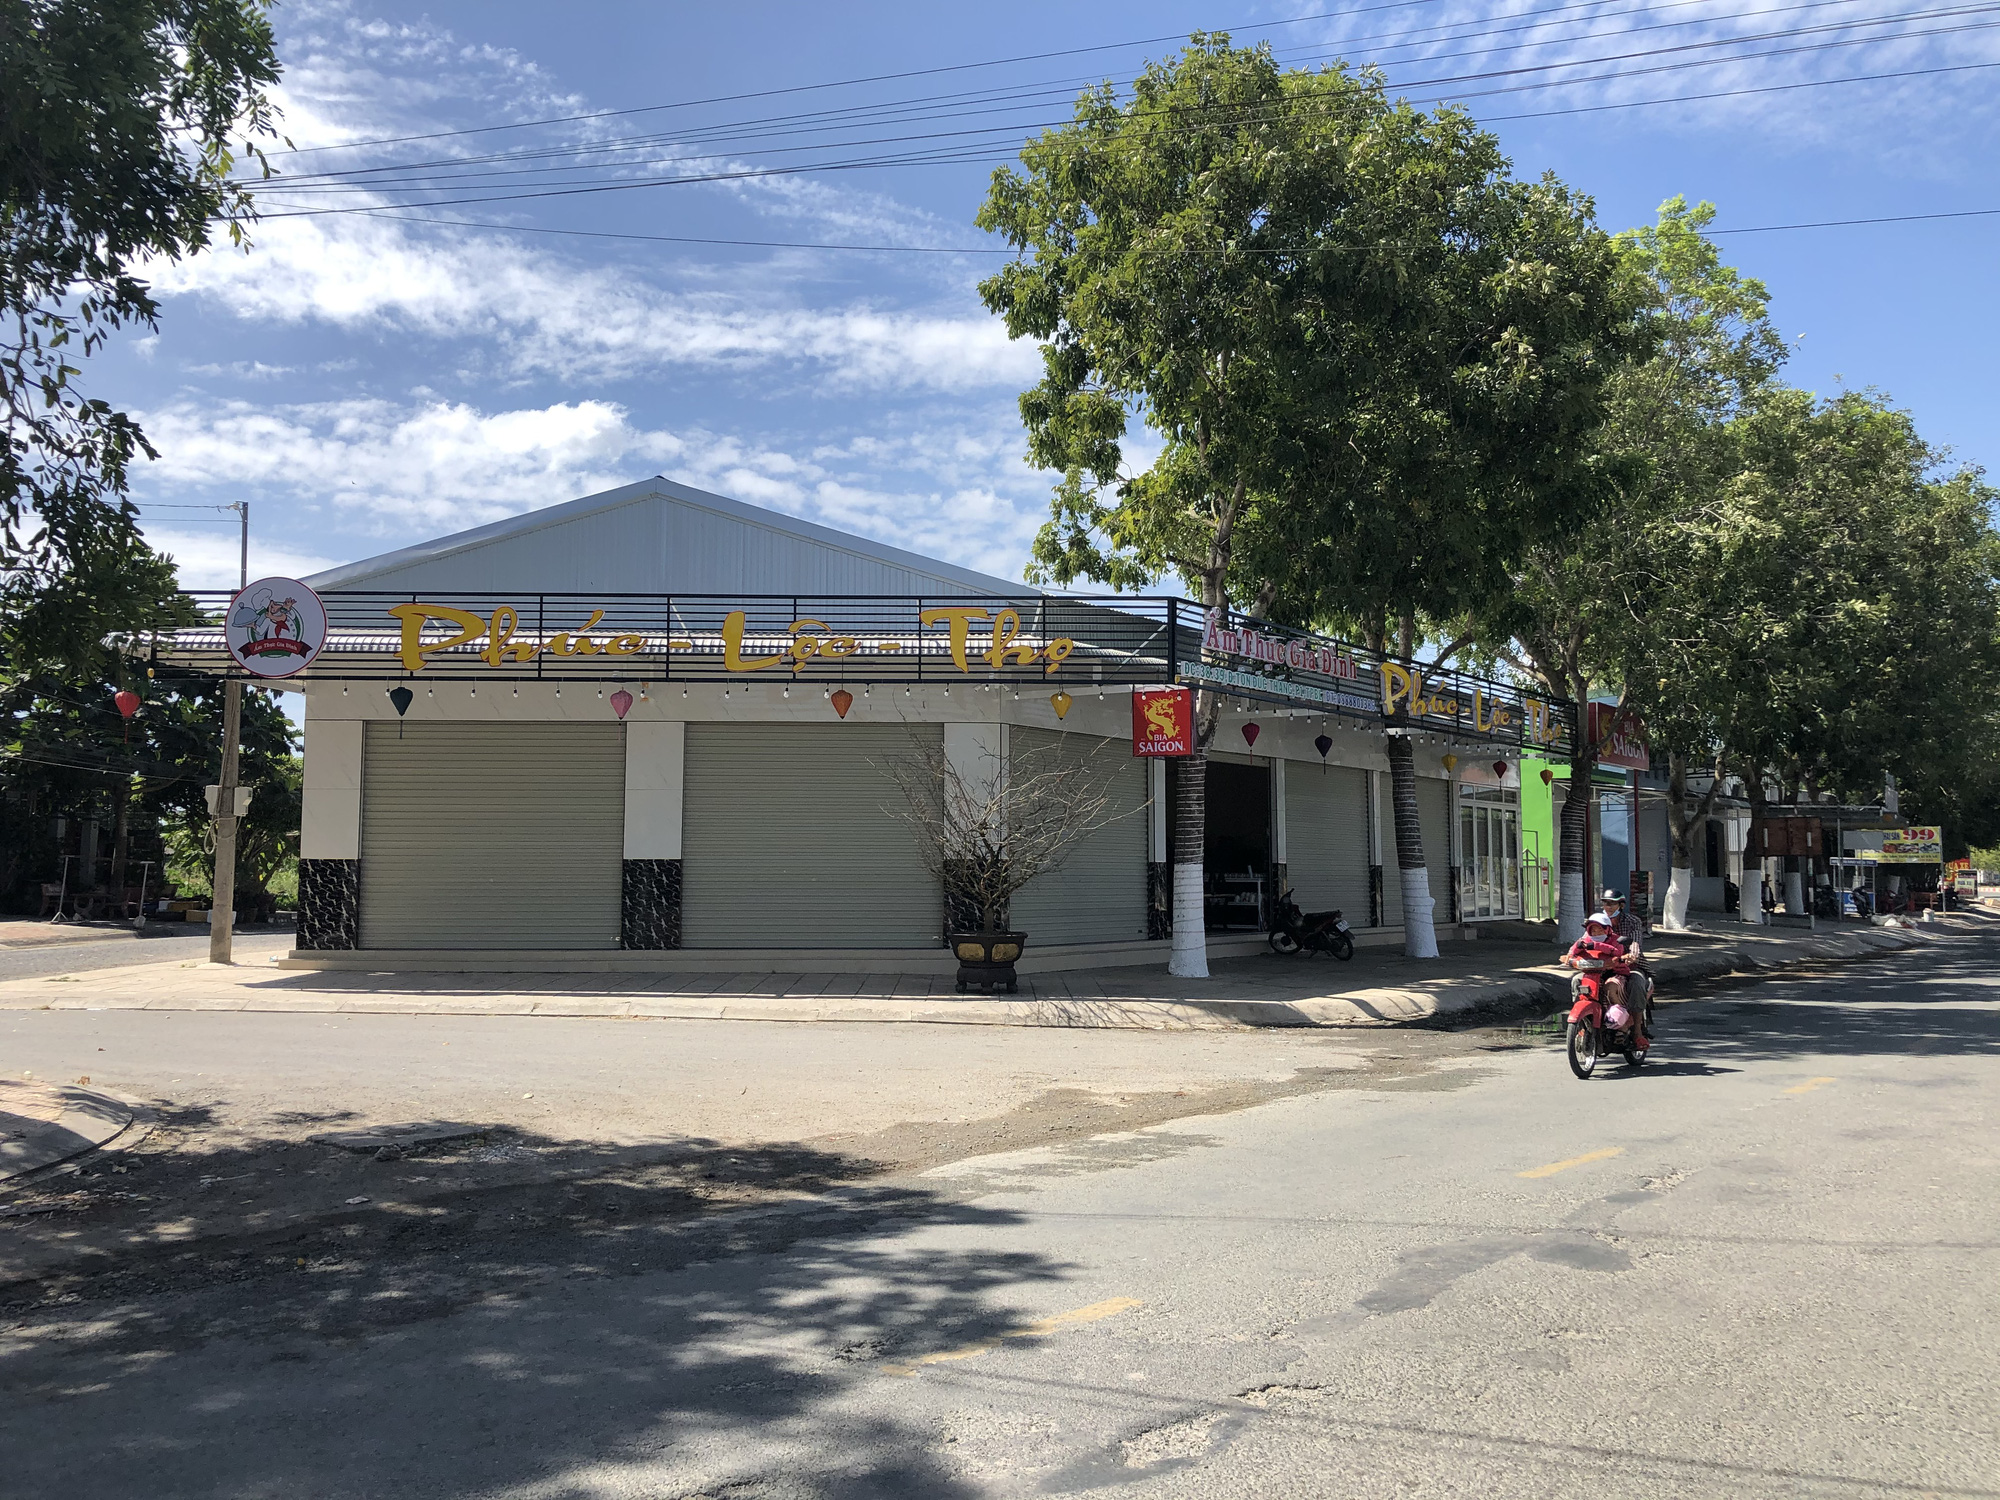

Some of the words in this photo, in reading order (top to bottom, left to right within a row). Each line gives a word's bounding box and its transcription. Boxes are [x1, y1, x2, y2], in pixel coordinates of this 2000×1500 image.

[387, 603, 649, 672] Phúc
[721, 609, 861, 673] Lộc
[918, 607, 1074, 673] Thọ
[1288, 639, 1317, 672] Gia
[1379, 661, 1459, 716] Phúc
[1138, 740, 1183, 753] SAIGON
[1153, 733, 1168, 741] BIA
[1902, 828, 1935, 841] 99
